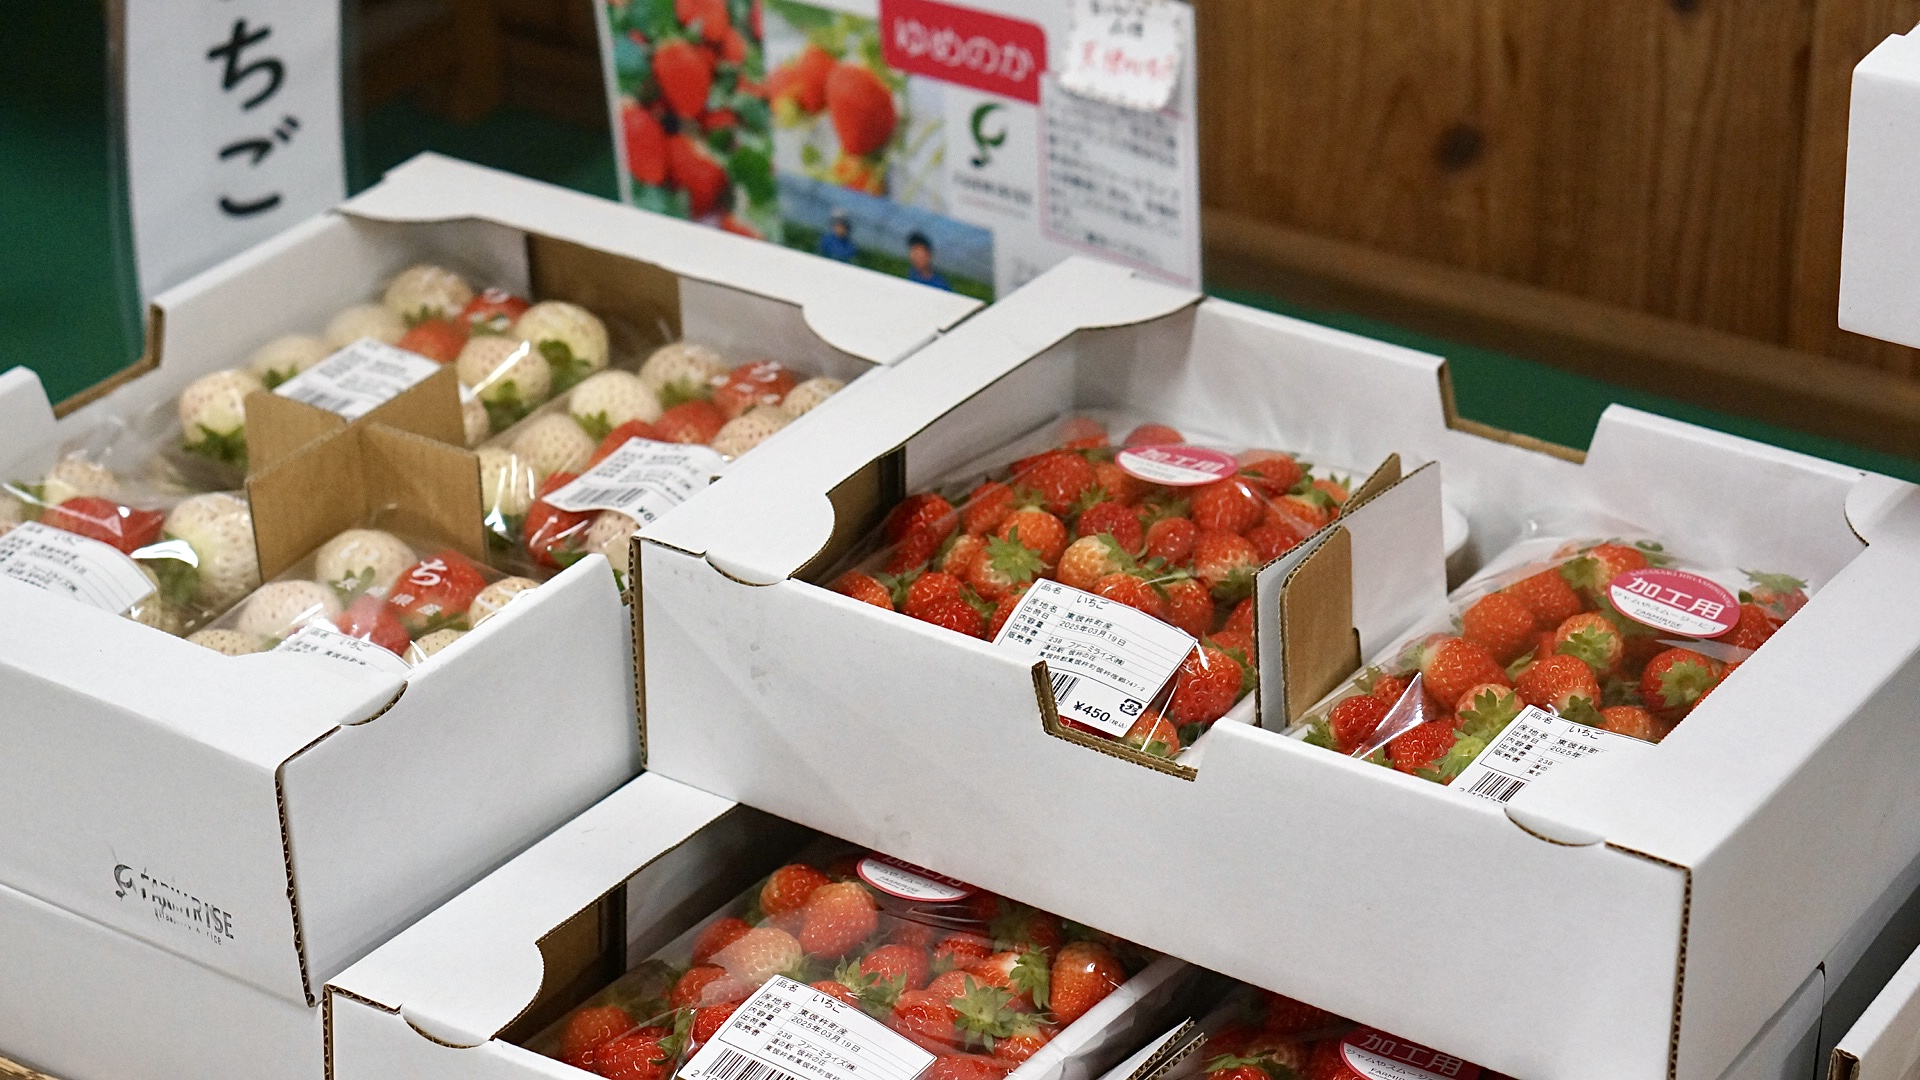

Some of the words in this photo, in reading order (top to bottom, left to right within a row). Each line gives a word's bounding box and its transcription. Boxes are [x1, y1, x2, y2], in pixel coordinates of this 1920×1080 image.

[892, 14, 1036, 83] ゆめのか
[206, 0, 301, 217] ちご
[1029, 598, 1058, 613] 産地名
[1041, 583, 1062, 595] 品名
[1076, 594, 1110, 610] いちご
[1625, 577, 1725, 621] 加工用
[1012, 622, 1038, 637] 出荷者
[1048, 636, 1063, 645] 238
[1018, 613, 1044, 628] 内容量
[1023, 605, 1050, 620] 出荷日
[1059, 620, 1127, 647] 2025年03月19日
[1007, 630, 1033, 645] 販売者
[1073, 700, 1112, 722] ¥450
[1531, 711, 1553, 724] 品名
[1568, 725, 1605, 740] いちご
[1518, 724, 1549, 740] 産地名
[1557, 739, 1604, 754] 東彼杵町
[1550, 745, 1585, 758] 2025年
[1537, 758, 1554, 766] 238
[761, 993, 792, 1009] 産地名
[776, 980, 799, 993] 品名
[812, 993, 848, 1014] いちご
[748, 1006, 775, 1021] 内容量
[754, 1000, 782, 1014] 出荷日
[791, 1015, 861, 1053] 2025年03月19日
[733, 1020, 760, 1037] 販売者
[740, 1014, 767, 1028] 出荷者
[777, 1030, 793, 1040] 238
[1346, 1048, 1433, 1080] ジャムやスムージ
[1359, 1033, 1464, 1077] 加工用
[690, 1069, 701, 1078] 2
